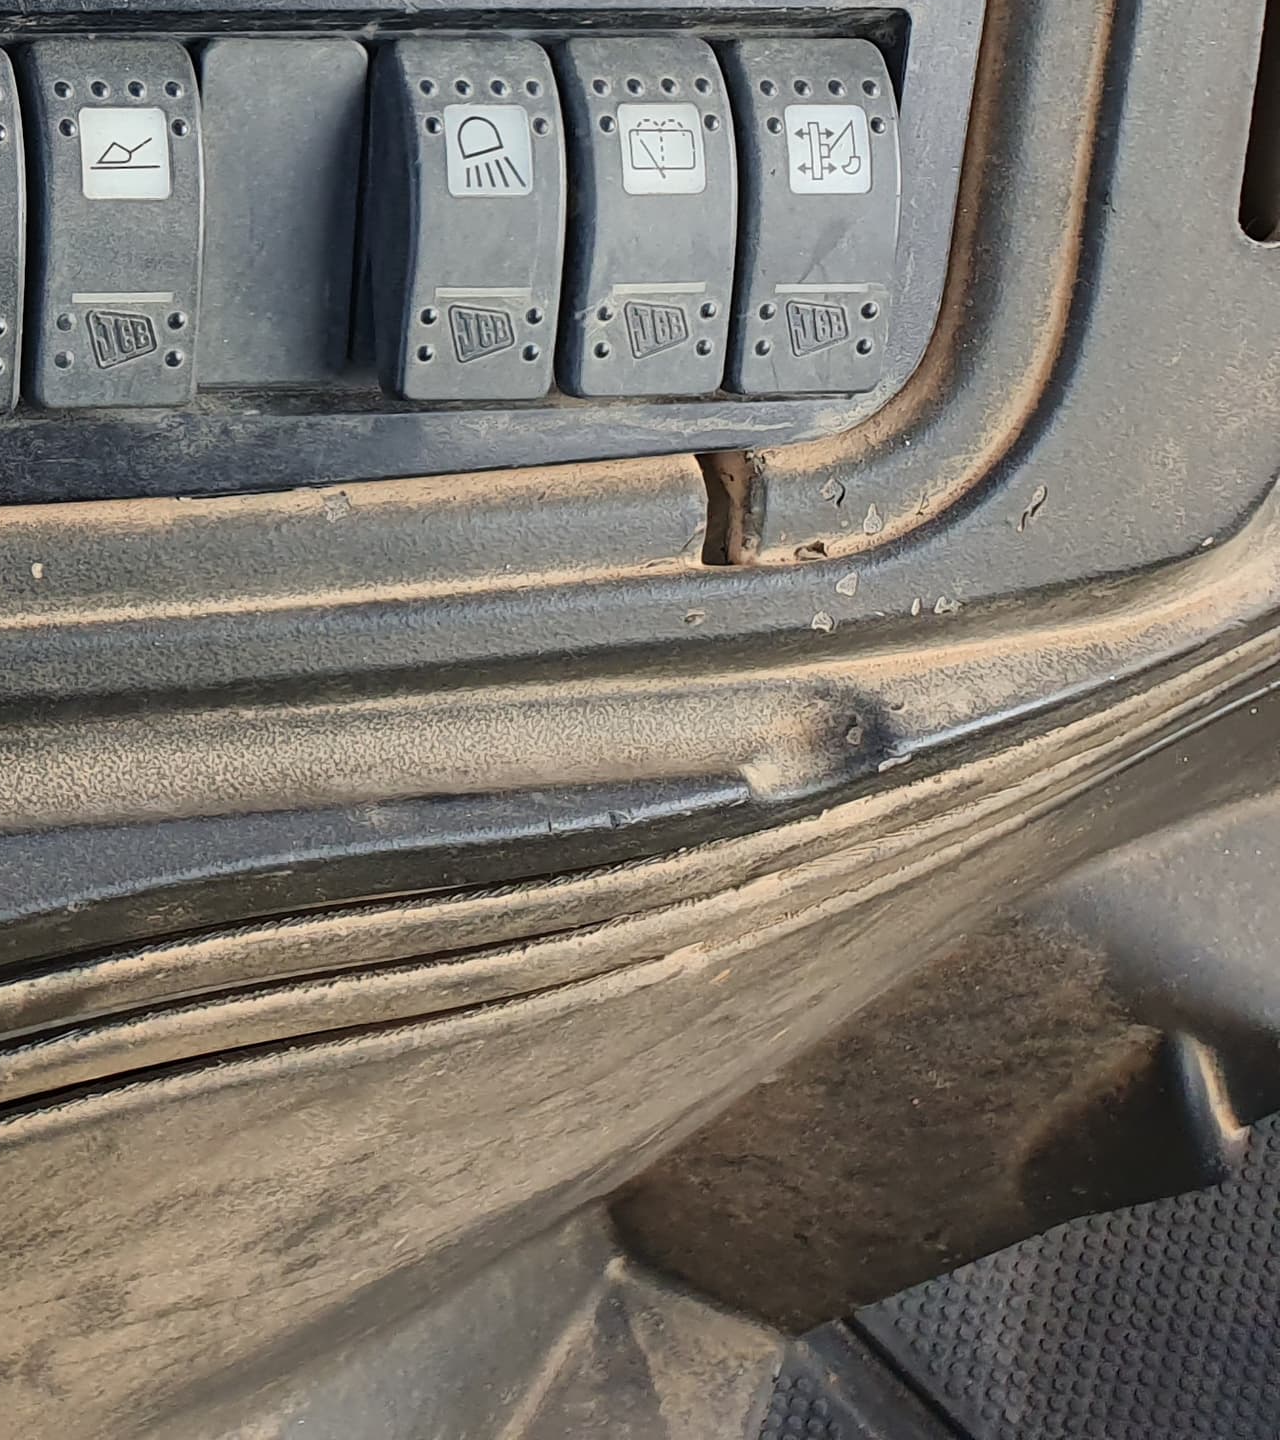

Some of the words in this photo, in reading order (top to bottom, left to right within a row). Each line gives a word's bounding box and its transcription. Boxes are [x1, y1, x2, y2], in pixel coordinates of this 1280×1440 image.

[99, 317, 151, 359] JCB
[458, 312, 509, 354] JCB
[632, 309, 685, 350] JCB
[794, 309, 844, 350] JCB
